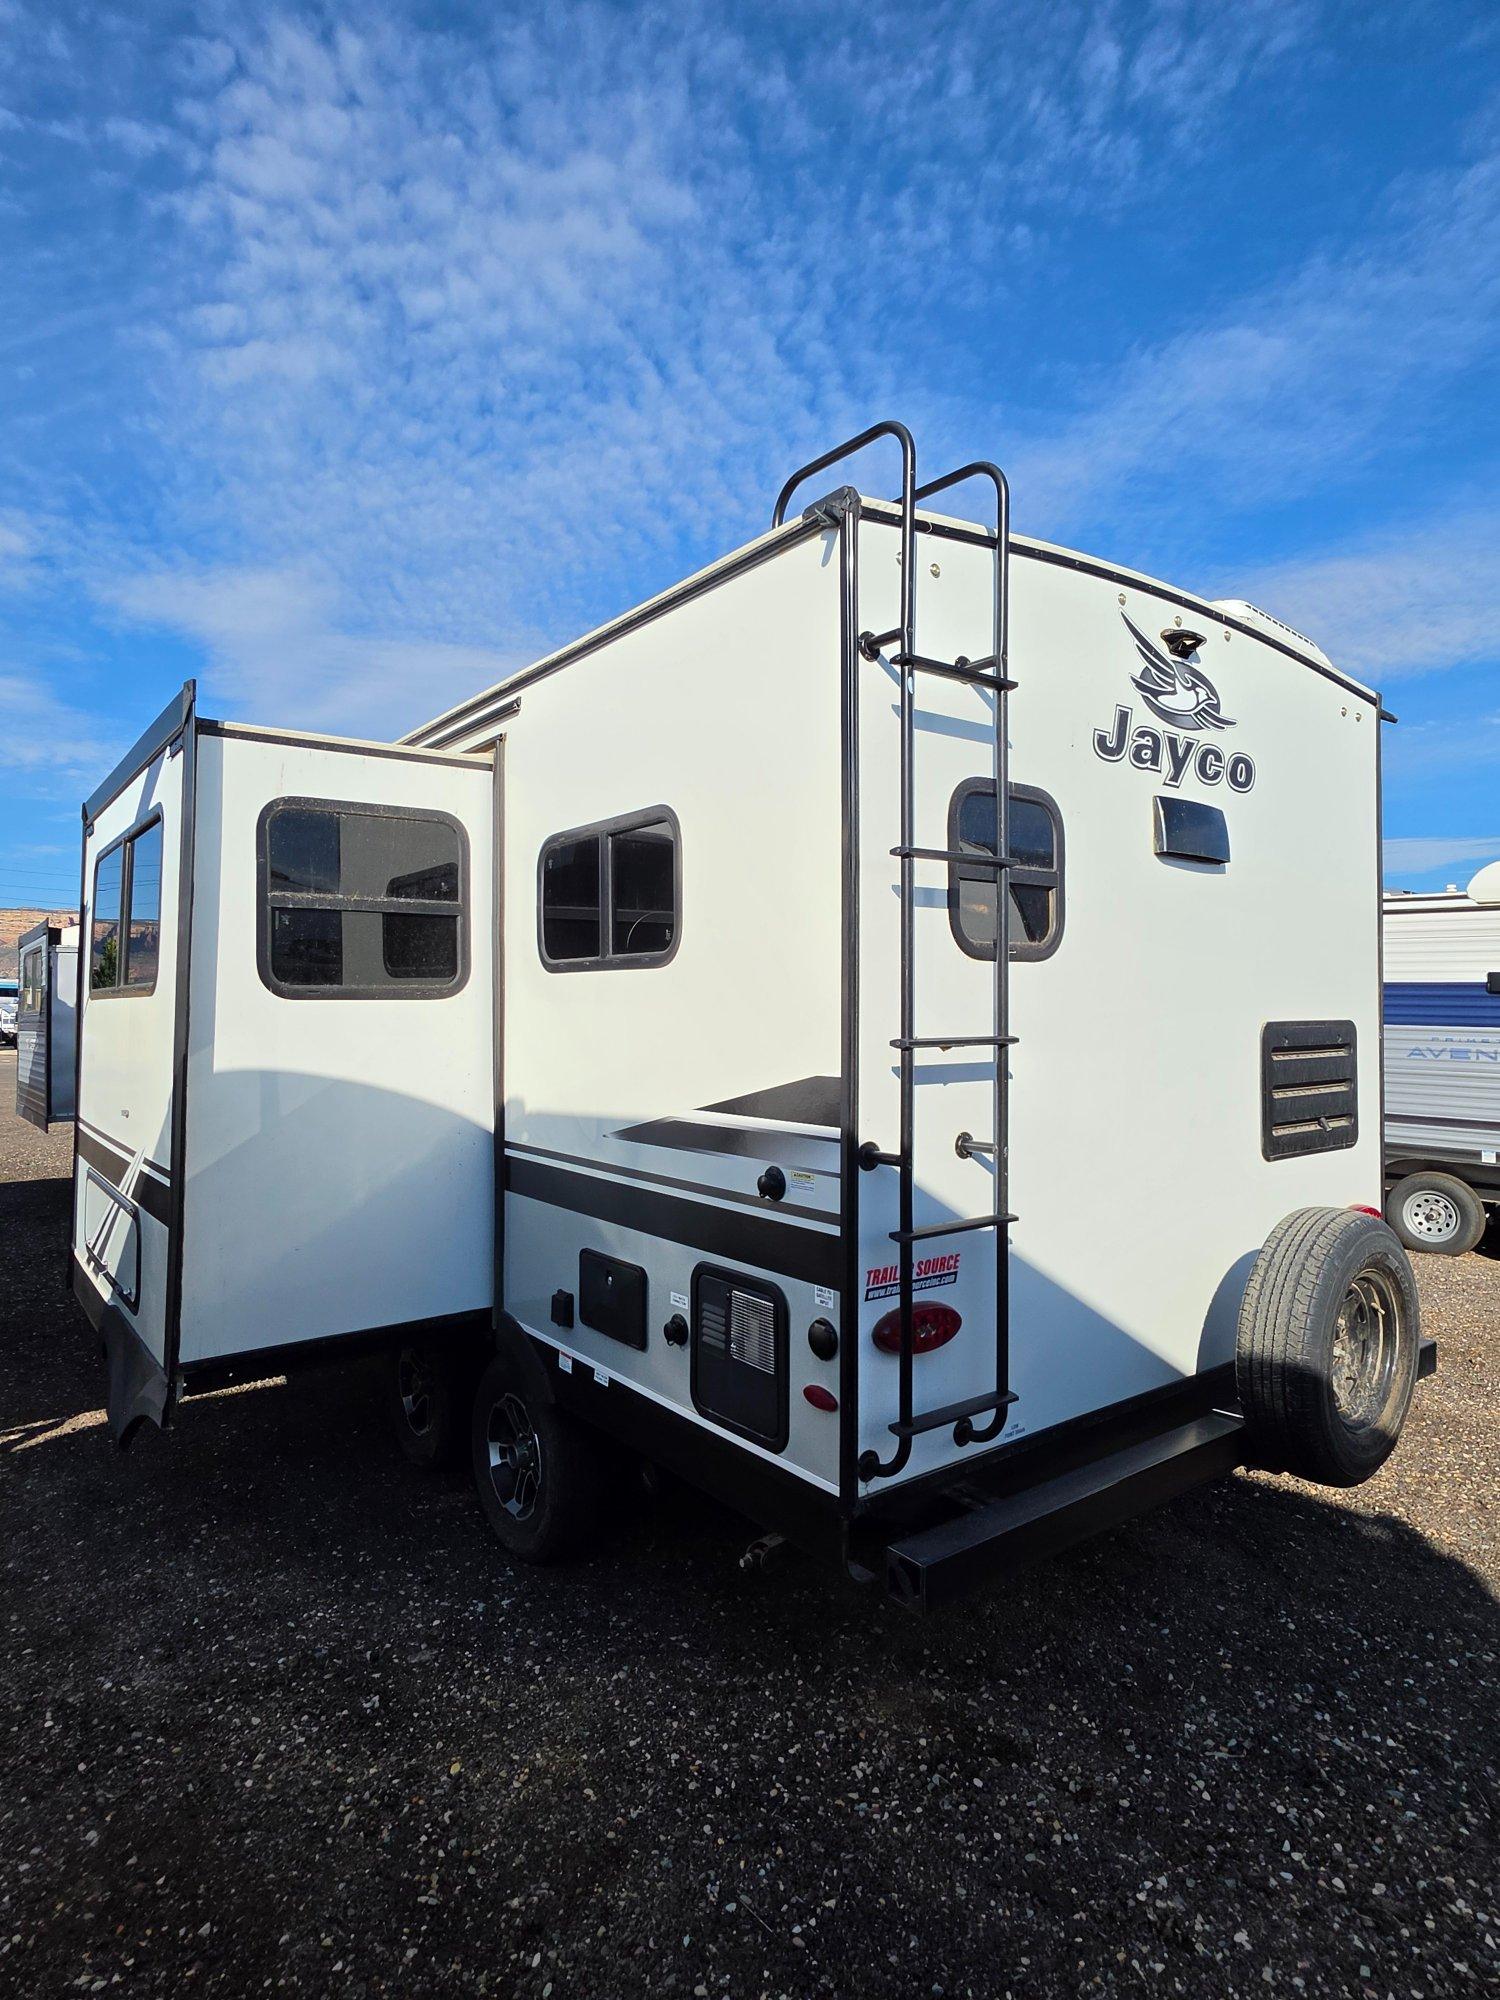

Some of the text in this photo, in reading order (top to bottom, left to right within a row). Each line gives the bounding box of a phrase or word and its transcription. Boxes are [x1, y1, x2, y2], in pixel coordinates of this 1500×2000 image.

[1093, 704, 1256, 794] Jayco
[866, 1253, 961, 1288] TRAIL SOURCE
[868, 1274, 956, 1300] www.trailourceinc.com
